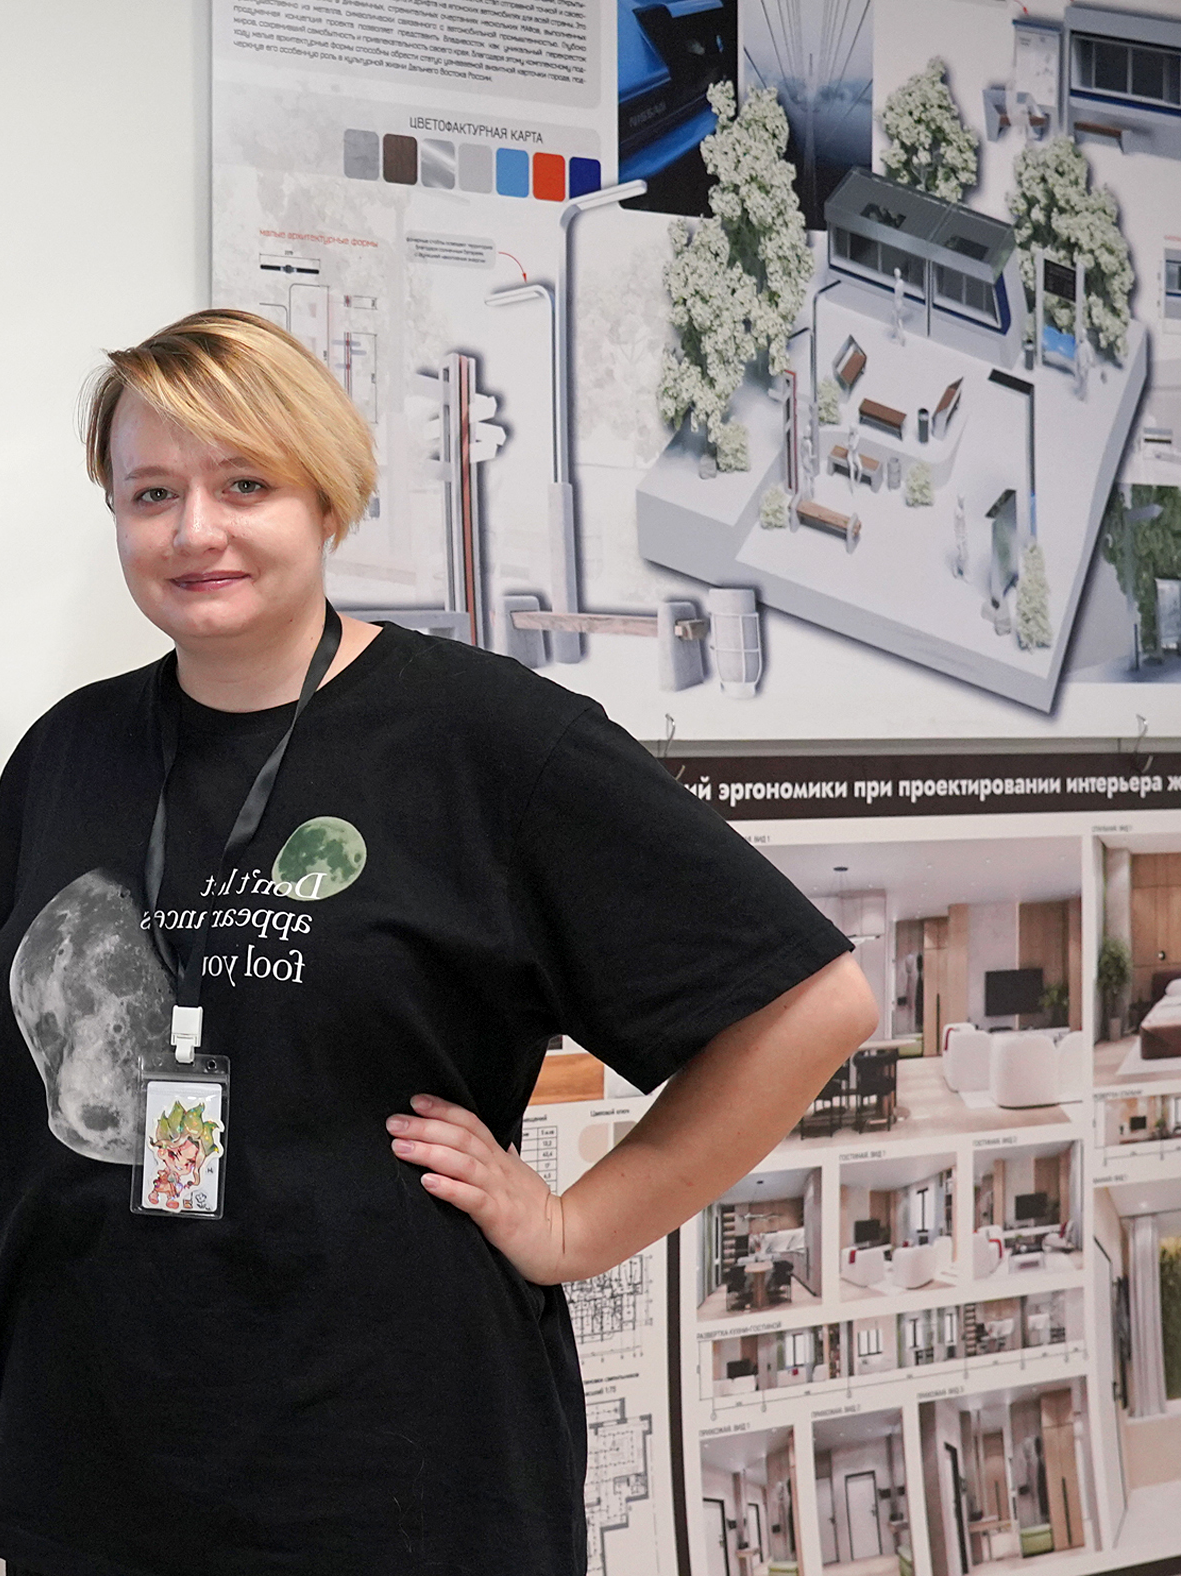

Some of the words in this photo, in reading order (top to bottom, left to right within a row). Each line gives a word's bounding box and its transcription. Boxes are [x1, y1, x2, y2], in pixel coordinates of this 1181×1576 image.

[410, 117, 507, 139] ЦВЕТОФАКТУРНАЯ
[510, 130, 543, 143] КАРТА
[718, 780, 847, 807] эргономики
[853, 780, 892, 804] при
[899, 777, 1061, 804] проектировании
[1065, 775, 1162, 799] интерьера
